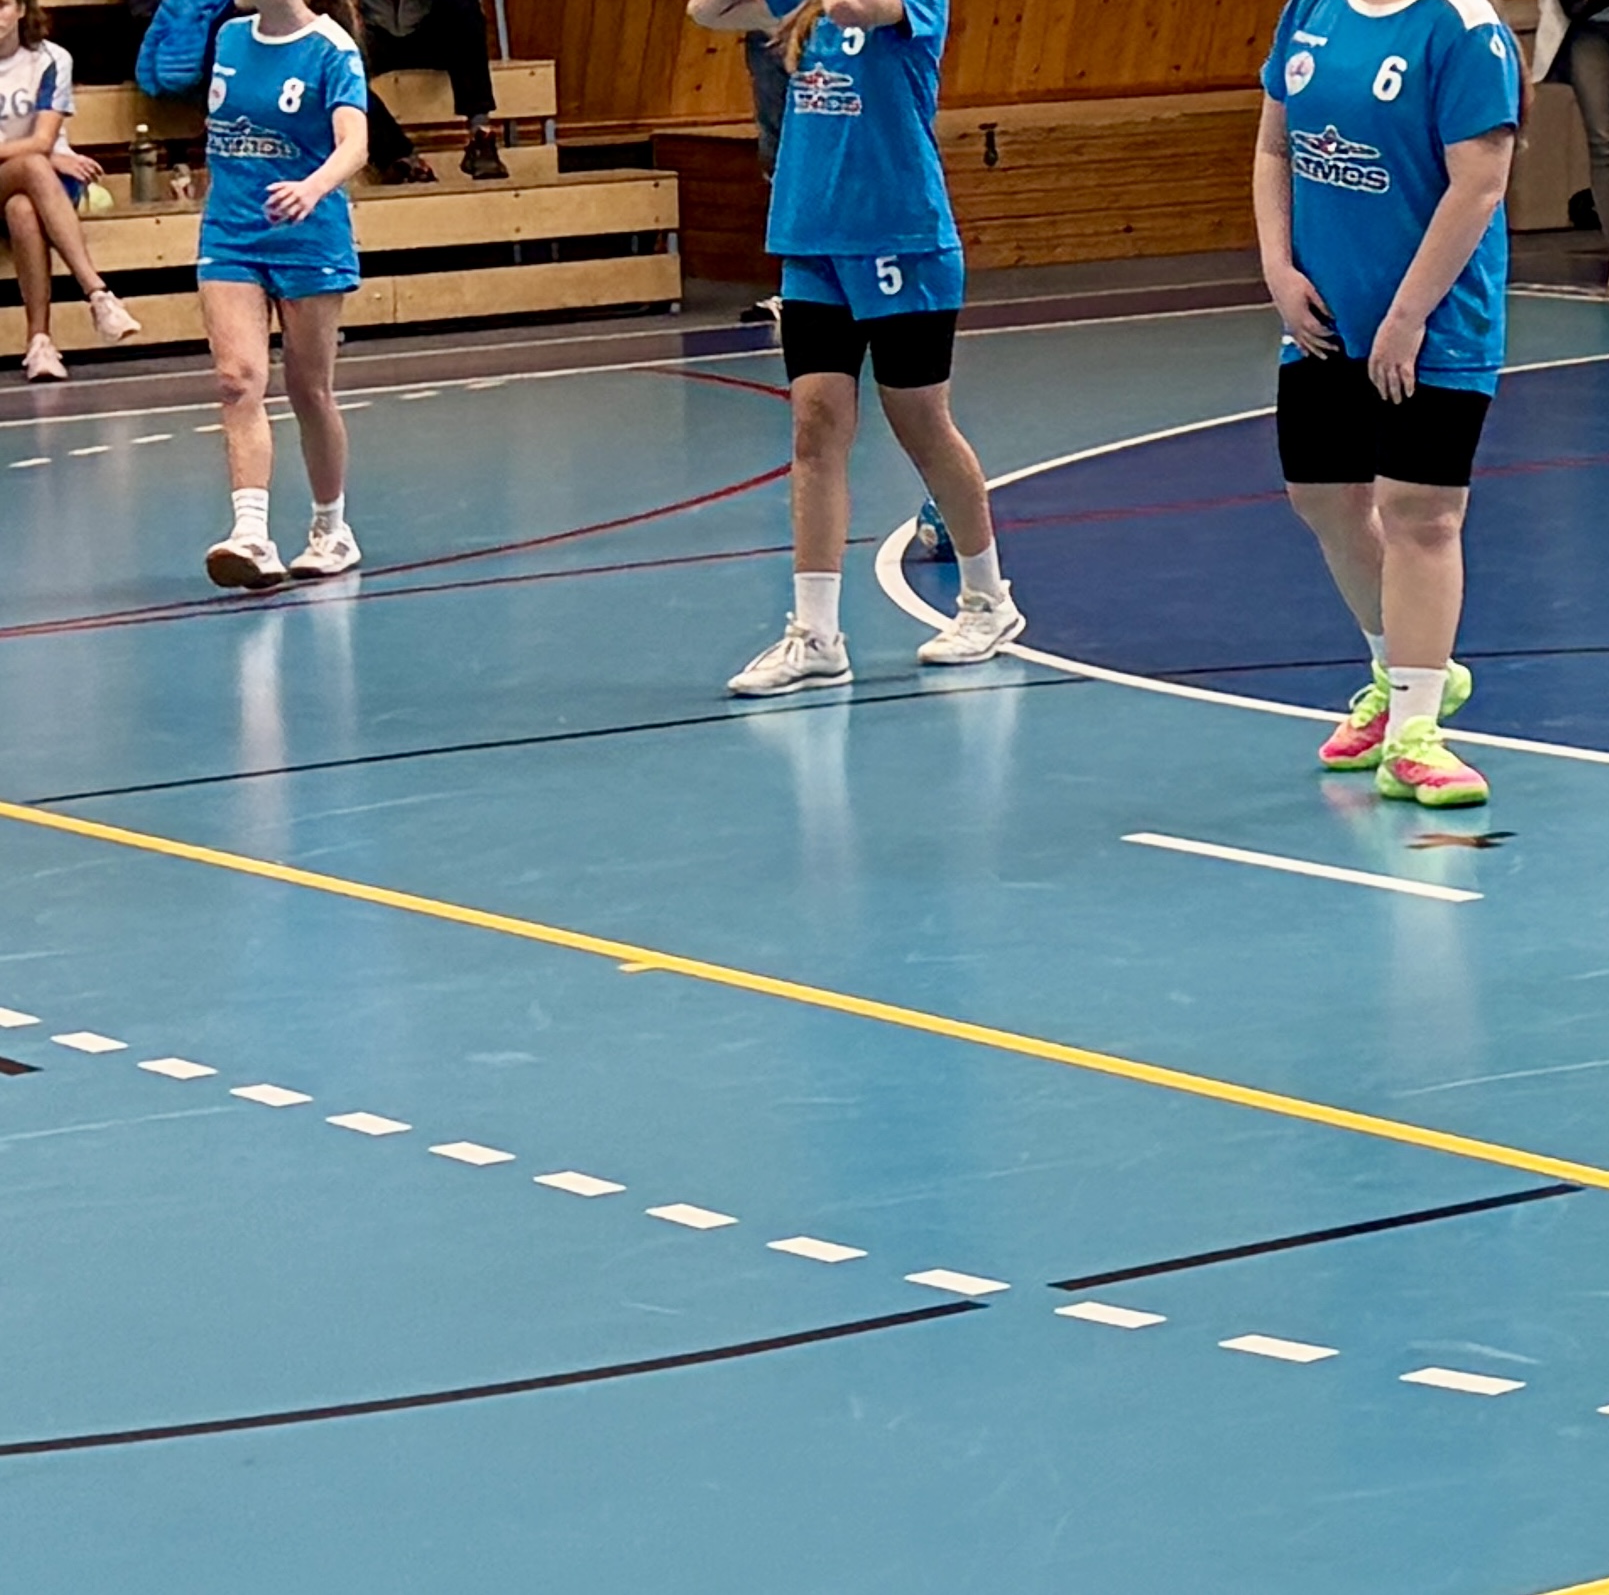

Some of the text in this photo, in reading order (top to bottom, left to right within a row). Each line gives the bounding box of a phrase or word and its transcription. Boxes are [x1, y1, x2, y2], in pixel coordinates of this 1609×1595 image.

[277, 77, 306, 114] 8
[1372, 55, 1408, 102] 6
[876, 254, 904, 296] 5
